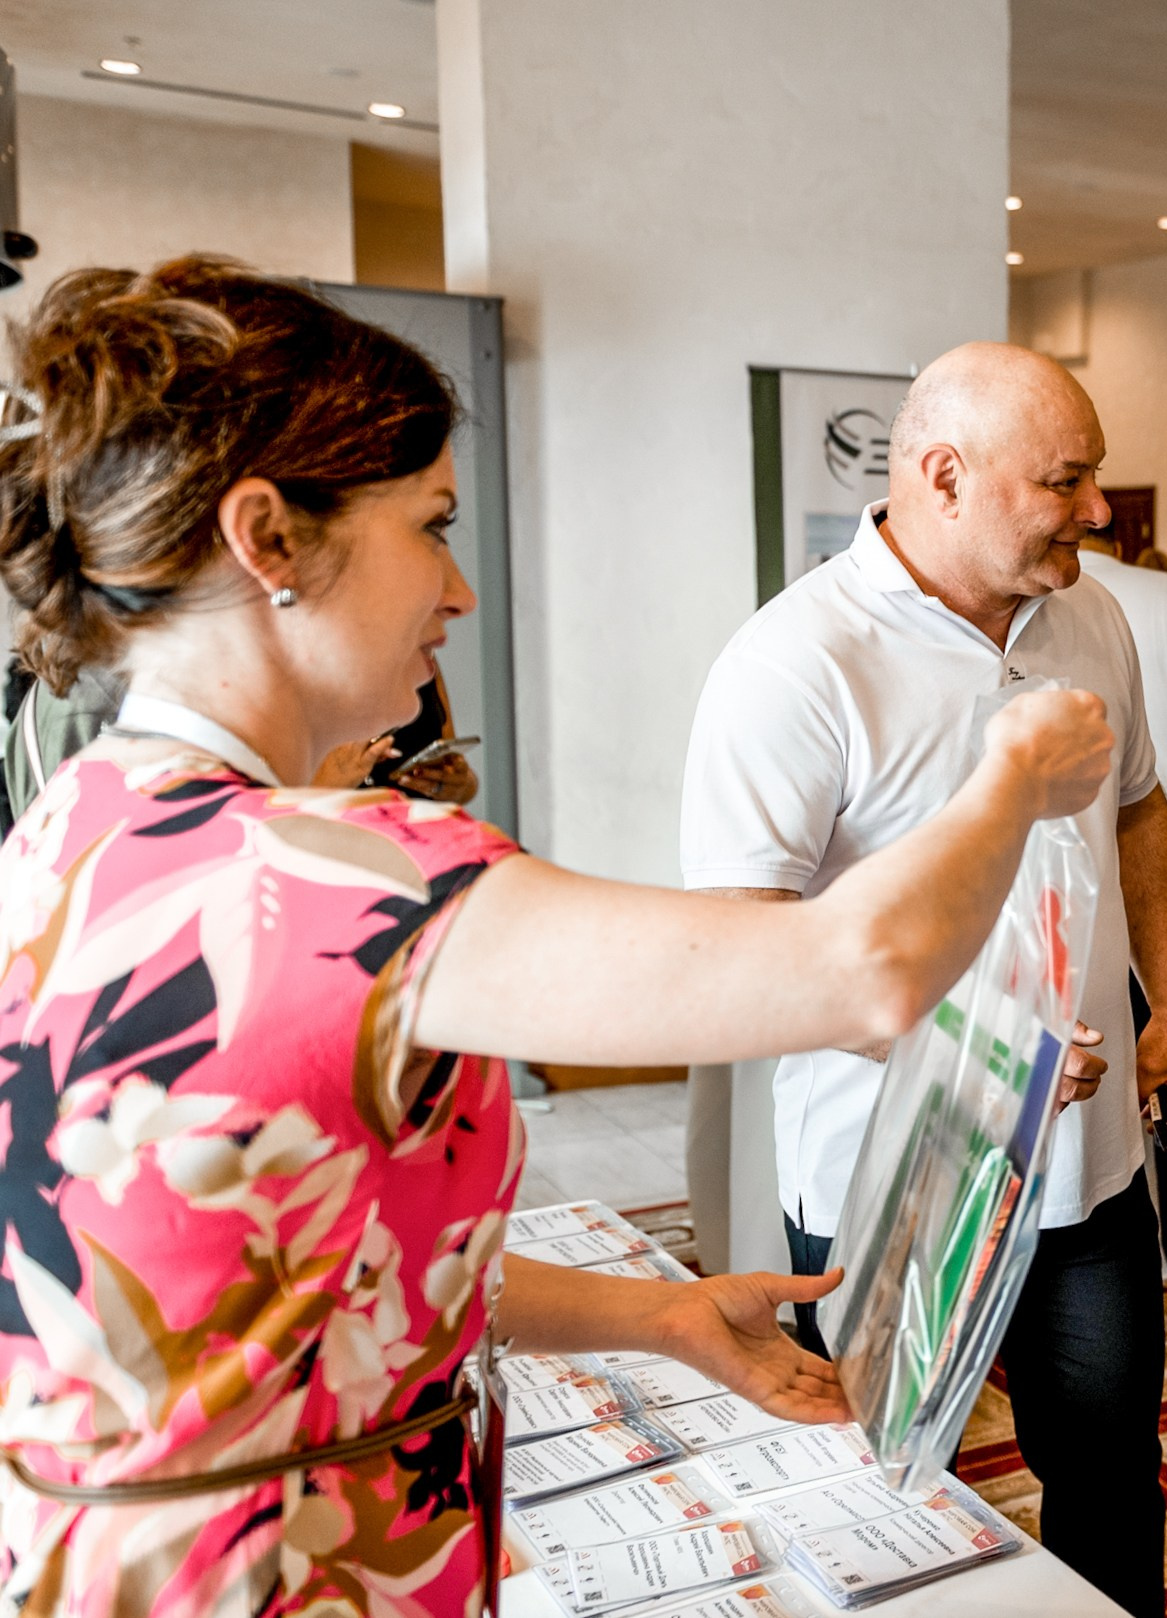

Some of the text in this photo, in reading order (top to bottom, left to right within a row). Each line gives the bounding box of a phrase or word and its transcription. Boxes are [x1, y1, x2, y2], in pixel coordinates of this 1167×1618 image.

[852, 1528, 879, 1551] Морем»
[866, 1524, 918, 1568] ООО «Доставка
[905, 1513, 926, 1530] Наталья
[925, 1530, 955, 1556] Алексеевна
